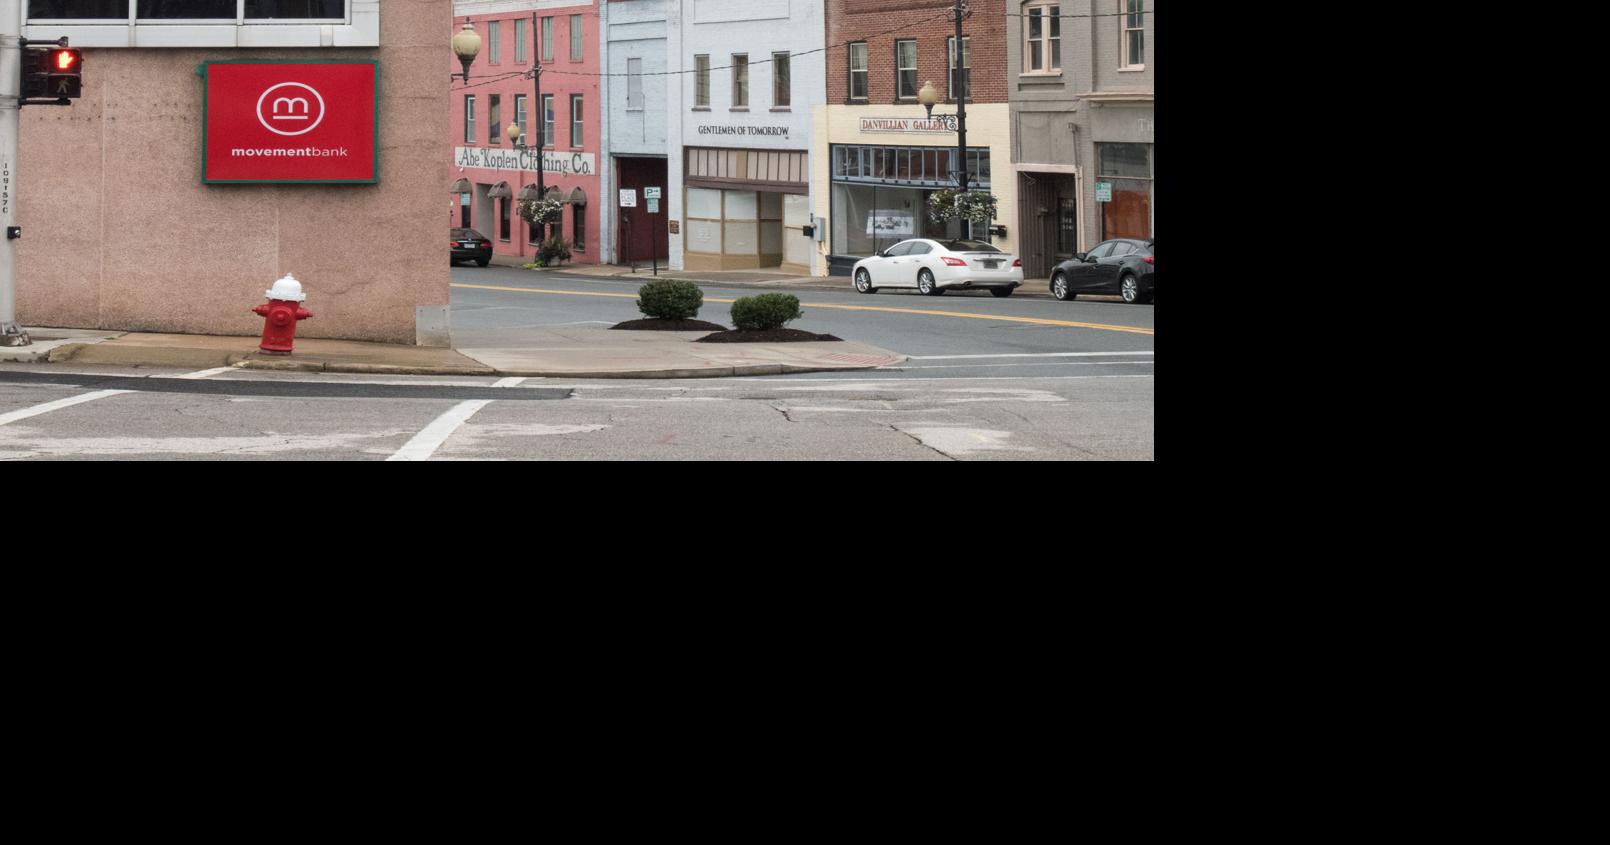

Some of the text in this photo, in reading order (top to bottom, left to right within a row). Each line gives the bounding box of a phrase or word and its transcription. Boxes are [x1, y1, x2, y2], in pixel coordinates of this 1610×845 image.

[698, 125, 789, 136] GENTLEMEN OF TOMORROW
[862, 119, 949, 131] DANVILLIAN GALLERY
[231, 146, 348, 157] movementbank
[458, 146, 591, 177] Abe Koplen Clohing Co.
[646, 189, 653, 197] P
